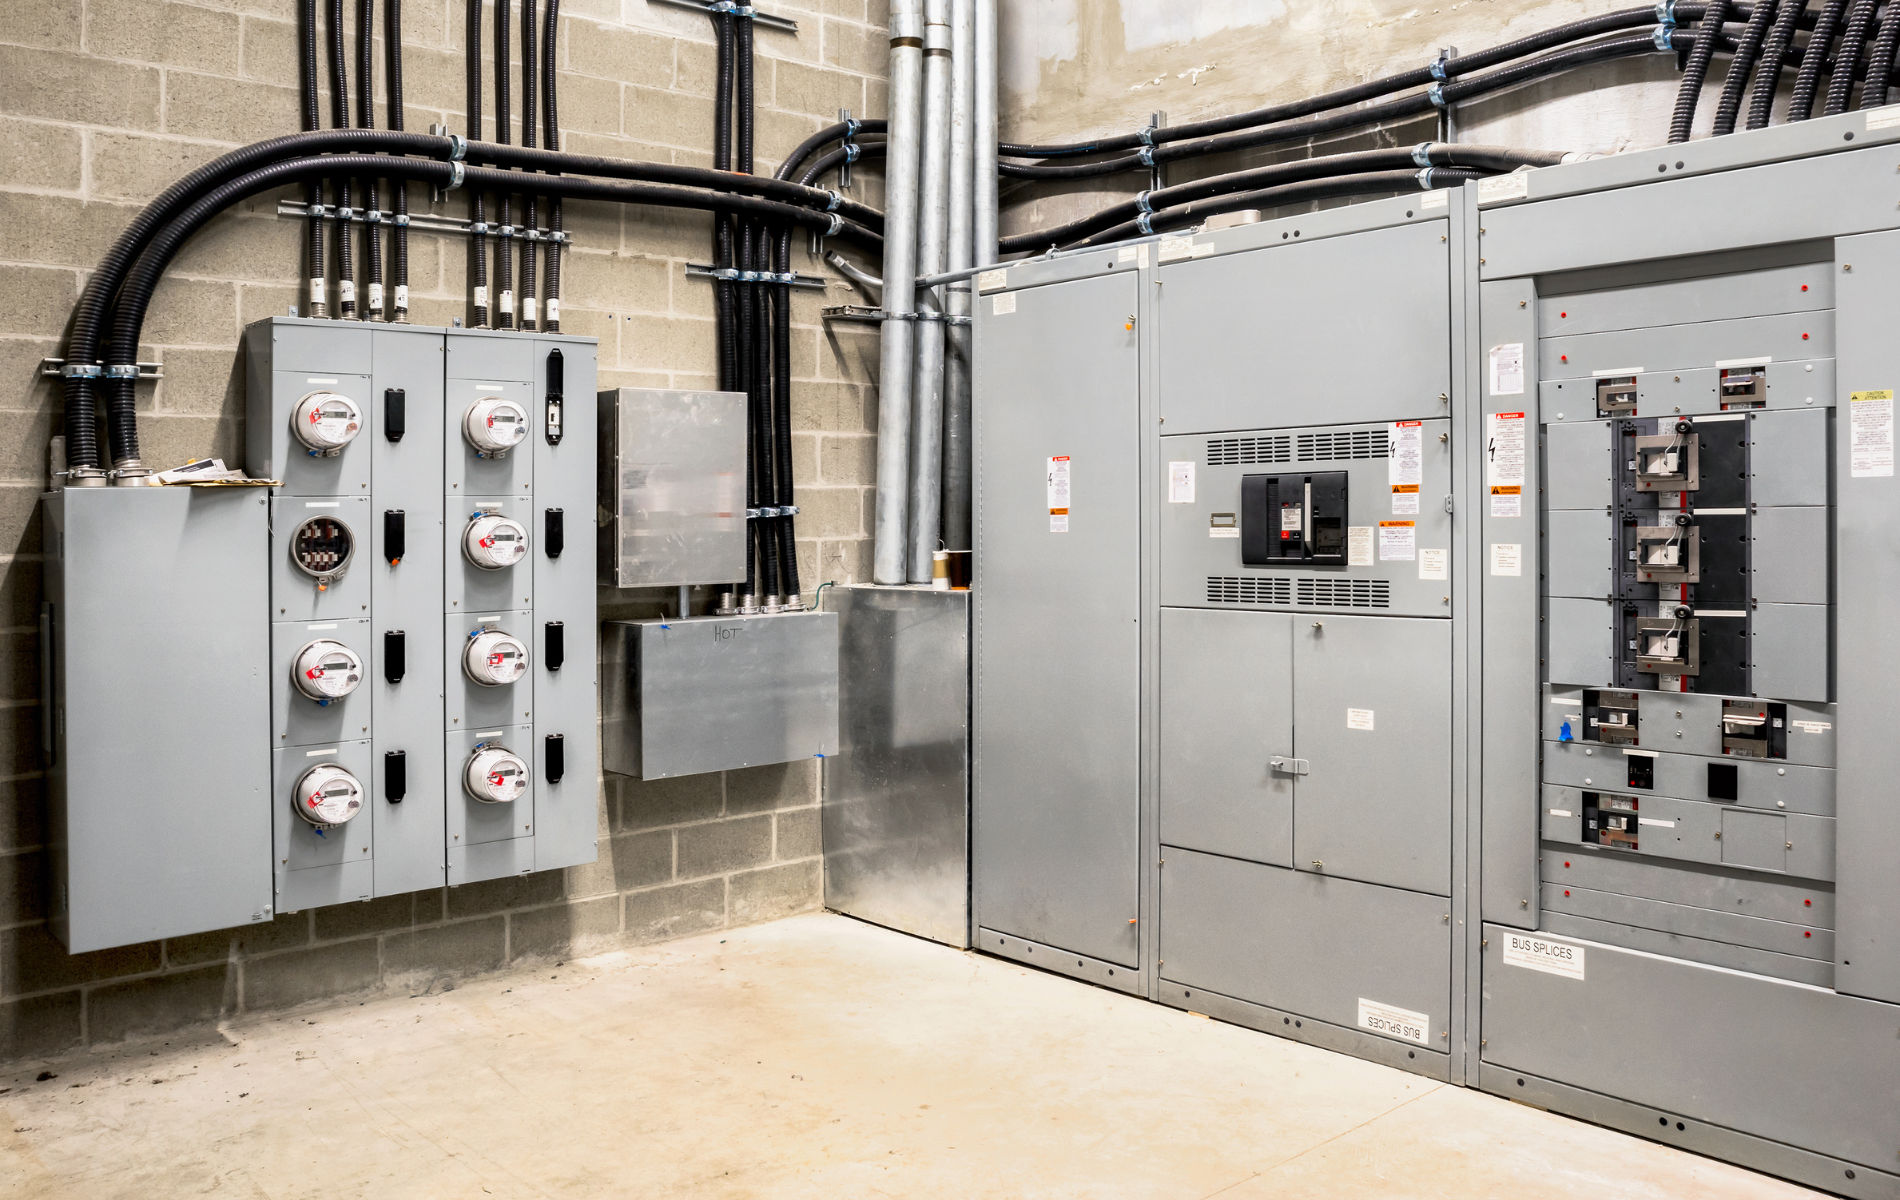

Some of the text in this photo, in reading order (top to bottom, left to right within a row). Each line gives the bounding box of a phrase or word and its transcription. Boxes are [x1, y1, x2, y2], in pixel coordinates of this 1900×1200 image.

[714, 625, 743, 642] HOT
[1512, 937, 1531, 951] BUS
[1533, 941, 1573, 960] SPLICES
[1367, 1016, 1402, 1034] SPLICES
[1403, 1025, 1420, 1040] BUS
